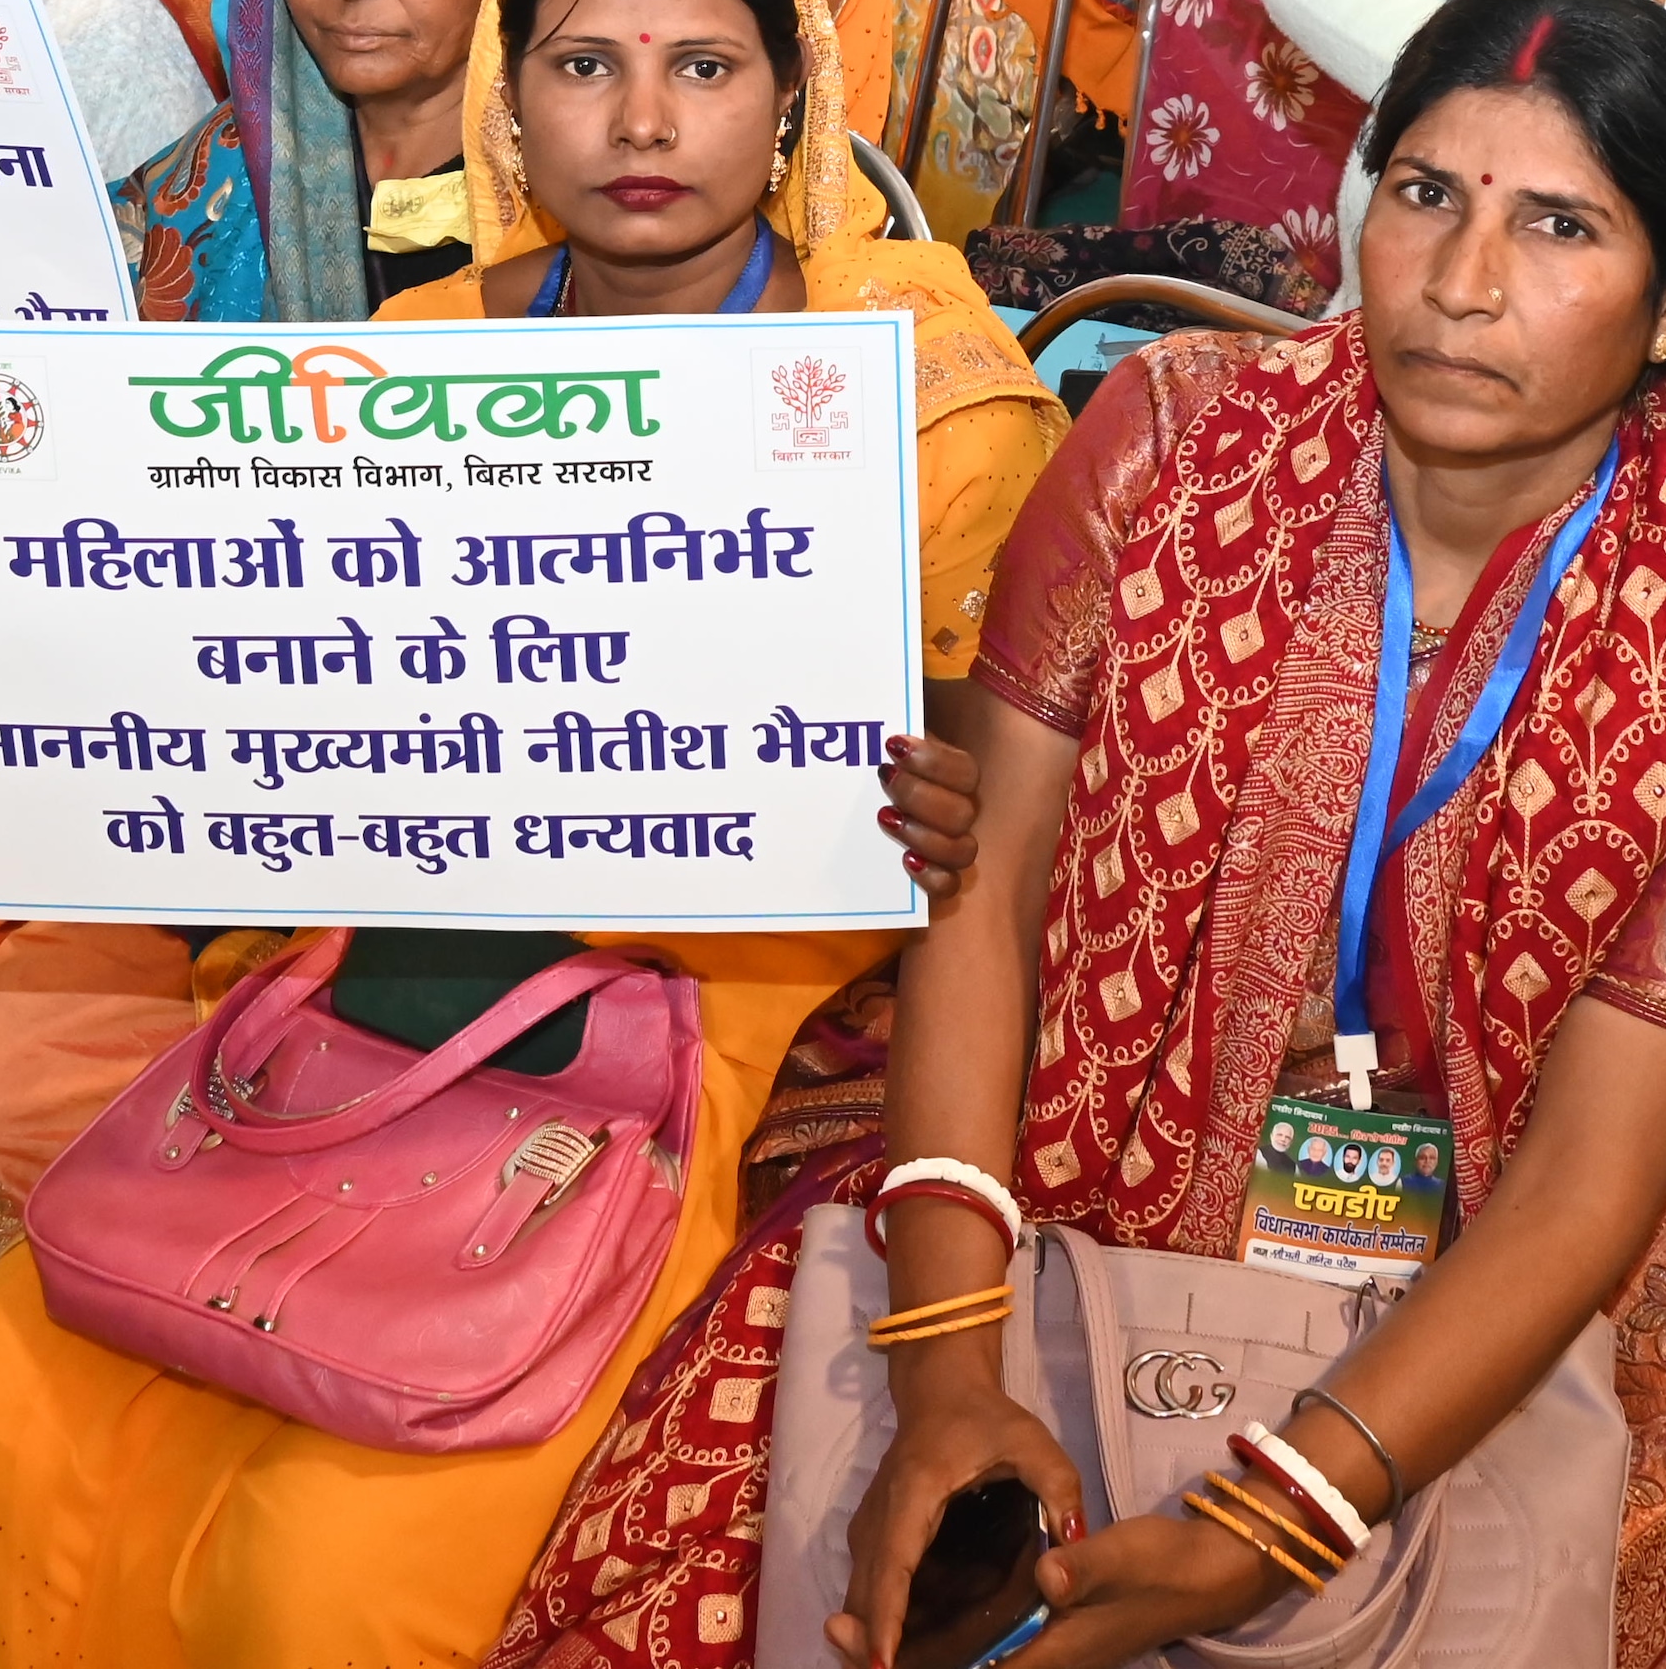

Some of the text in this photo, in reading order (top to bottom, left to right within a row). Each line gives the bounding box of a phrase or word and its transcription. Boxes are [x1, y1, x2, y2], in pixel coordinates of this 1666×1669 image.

[127, 345, 661, 444] जीविका
[146, 453, 654, 493] ग्रामीण विकास विभाग, बिहार सरकार
[3, 507, 815, 591] महिलाओं को आत्मनिर्भर
[192, 614, 630, 685] बनाने के लिए
[225, 711, 504, 788] मुख्यमंत्री
[523, 709, 729, 773] नीतीश
[753, 705, 885, 770] भैया
[102, 795, 757, 875] को बहुत-बहुत धन्यवाद
[1254, 1205, 1427, 1253] विधानसभा कार्यकर्ता सम्मेलन
[1293, 1182, 1400, 1222] एनडीए
